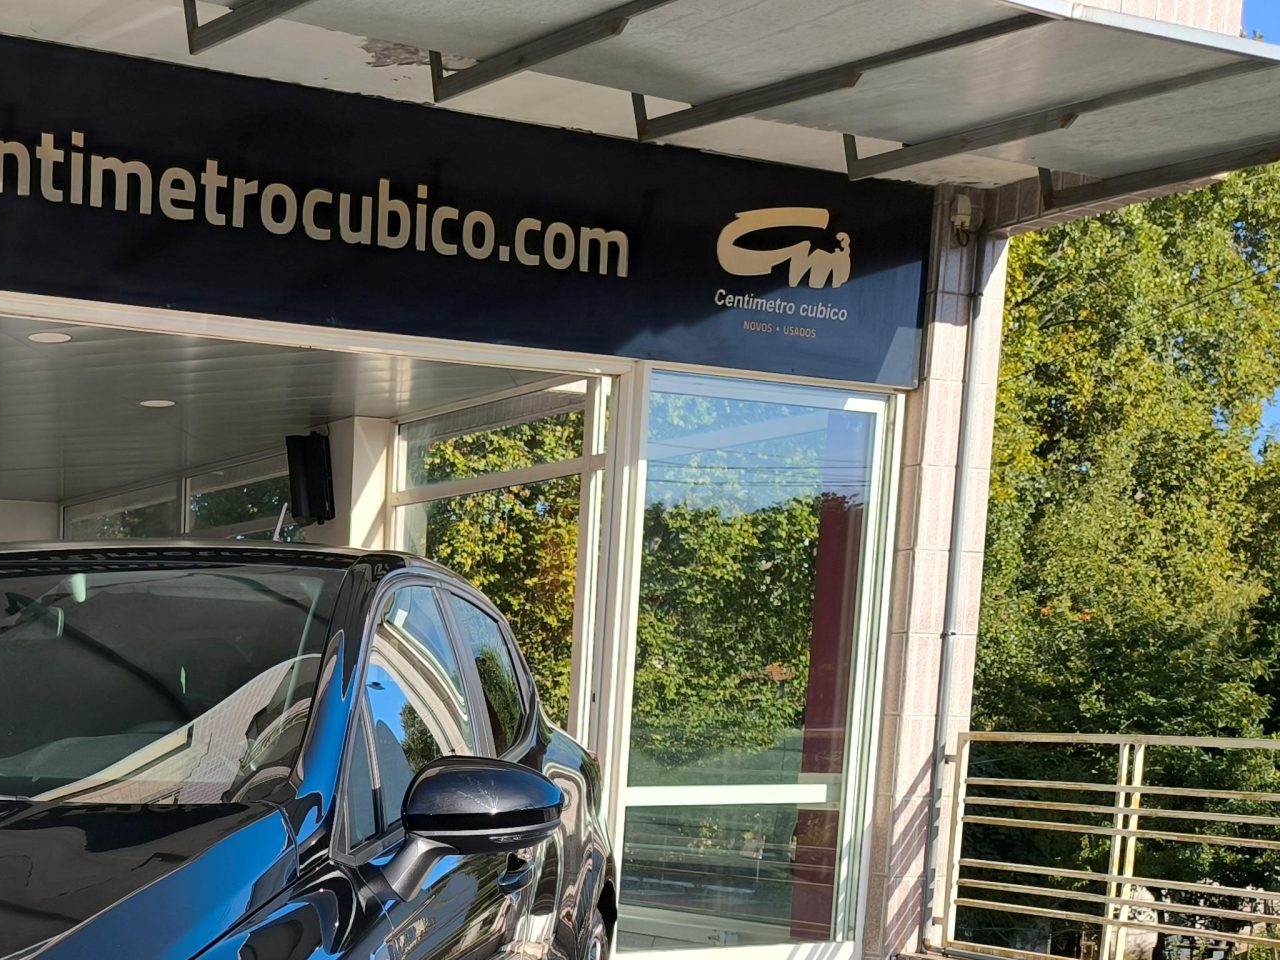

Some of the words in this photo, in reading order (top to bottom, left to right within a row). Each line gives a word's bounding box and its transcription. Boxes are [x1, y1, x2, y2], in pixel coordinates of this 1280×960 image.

[714, 288, 796, 316] Centimetro
[799, 302, 848, 321] cubico
[743, 320, 773, 333] NOVOS
[783, 326, 817, 338] USADOS
